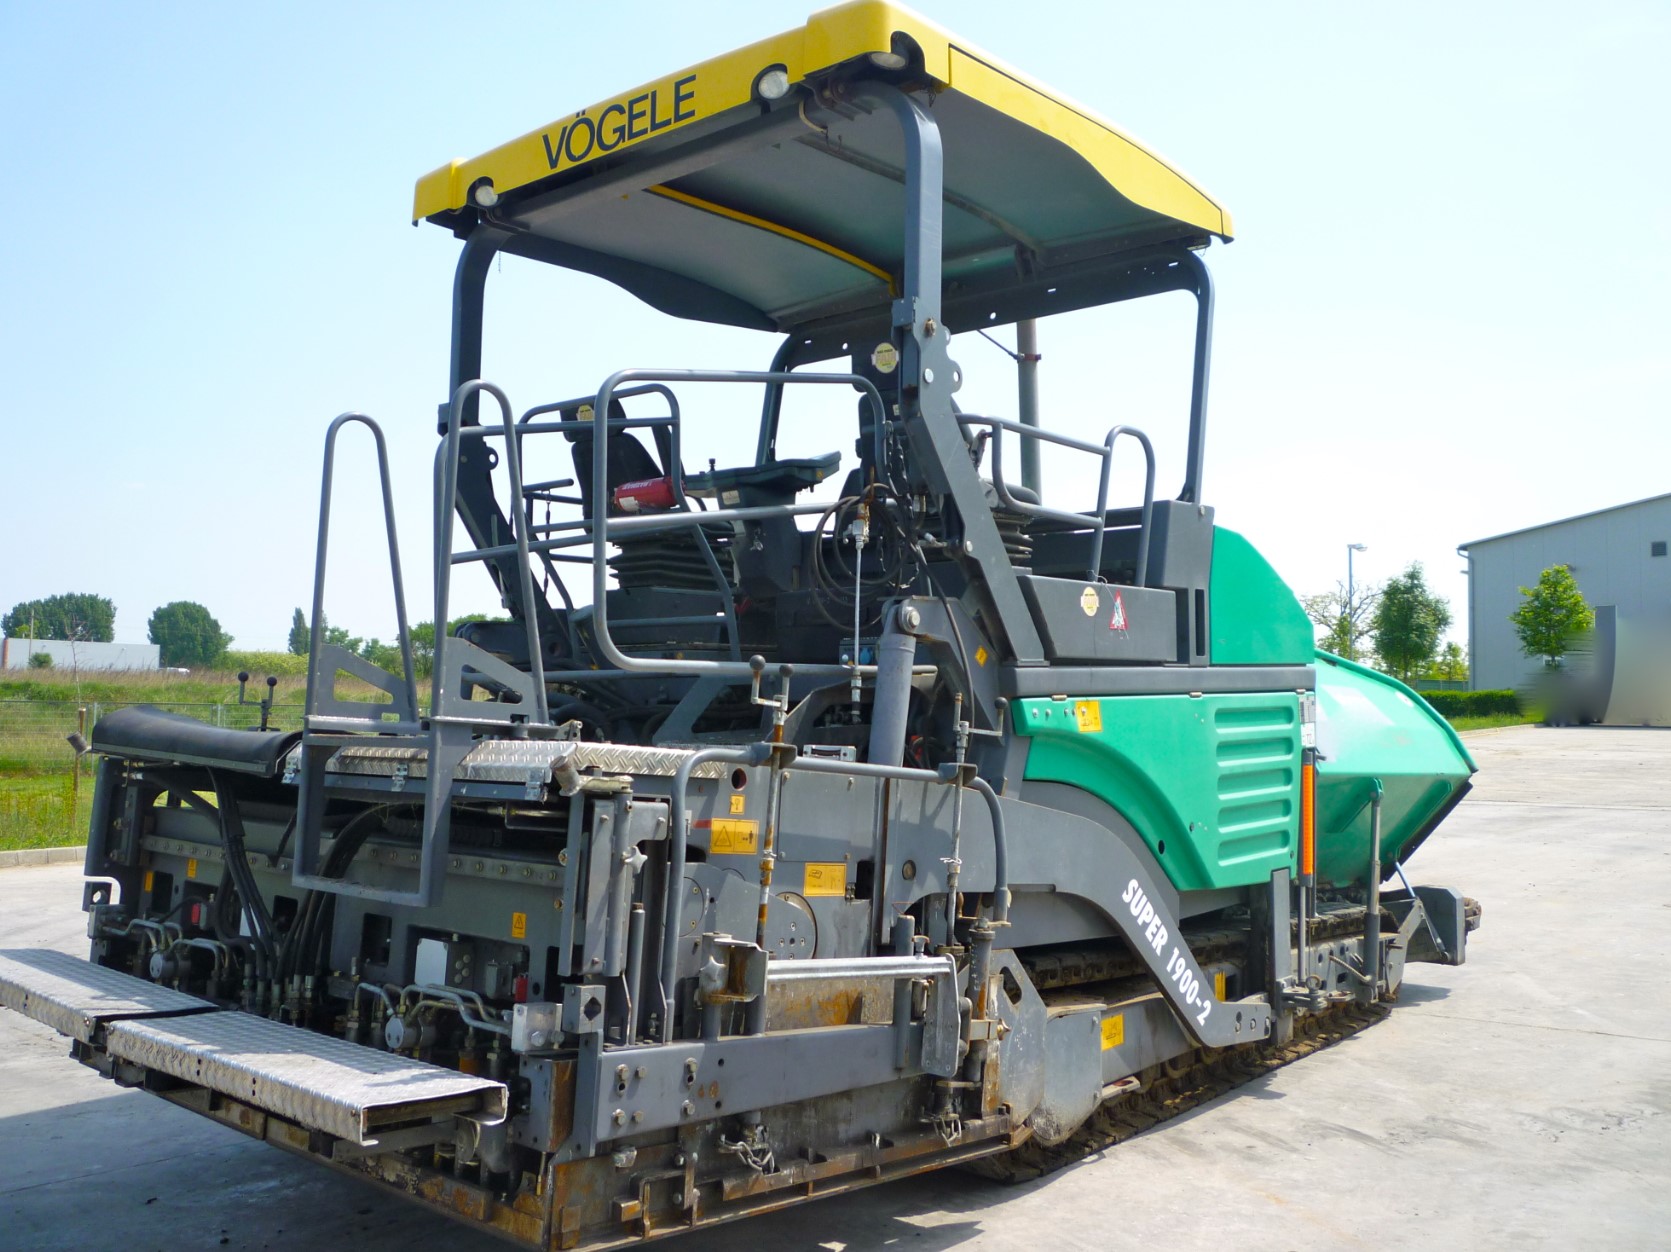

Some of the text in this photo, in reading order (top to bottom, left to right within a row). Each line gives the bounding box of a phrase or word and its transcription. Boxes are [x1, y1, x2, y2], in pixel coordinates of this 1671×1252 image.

[542, 74, 697, 170] VÖGELE
[1121, 878, 1212, 1027] SUPER 1900-2
